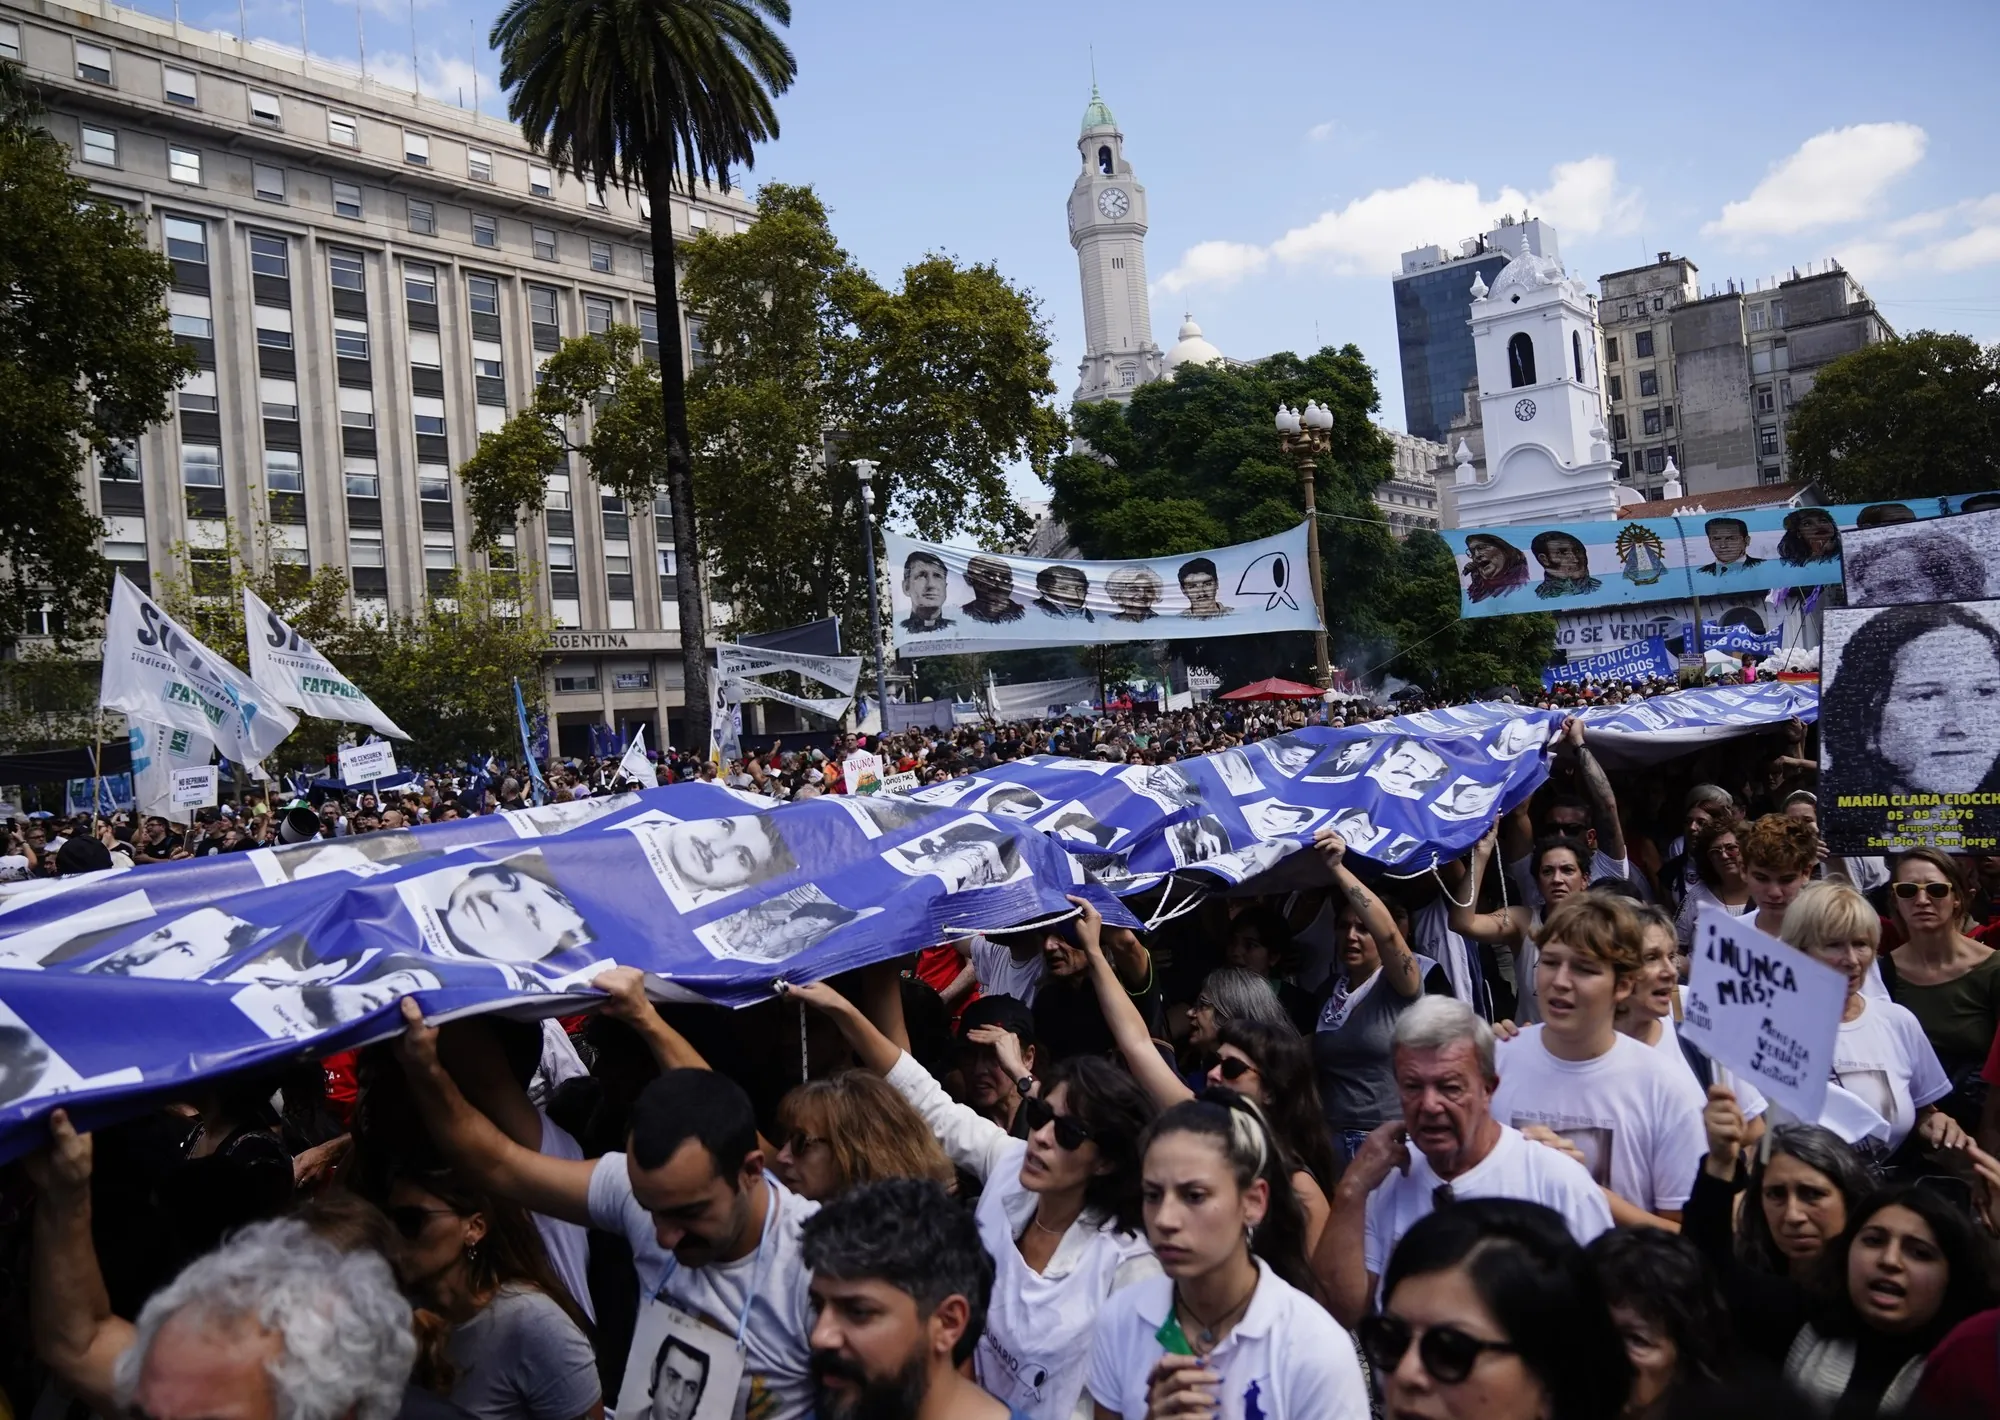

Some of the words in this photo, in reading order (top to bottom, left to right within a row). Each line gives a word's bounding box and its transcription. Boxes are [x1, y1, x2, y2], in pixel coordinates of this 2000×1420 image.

[1581, 626, 1603, 643] SE
[1609, 622, 1669, 641] VENDE
[543, 634, 628, 648] RGENTINA
[1548, 641, 1650, 679] TELEFONICOS
[727, 665, 747, 673] PARA
[849, 757, 876, 772] NUNCA
[178, 778, 185, 786] NO
[1837, 793, 1889, 807] MARÍA
[1890, 794, 1941, 807] CLARA
[1887, 810, 1904, 820] 05
[1912, 810, 1930, 820] 09
[1940, 809, 1974, 820] 1976
[1897, 823, 1930, 834] Grupo
[1932, 823, 1964, 832] Scout
[1867, 837, 1893, 847] San
[1916, 836, 1926, 846] X
[1935, 836, 1959, 847] San
[1961, 836, 1997, 848] Jorge
